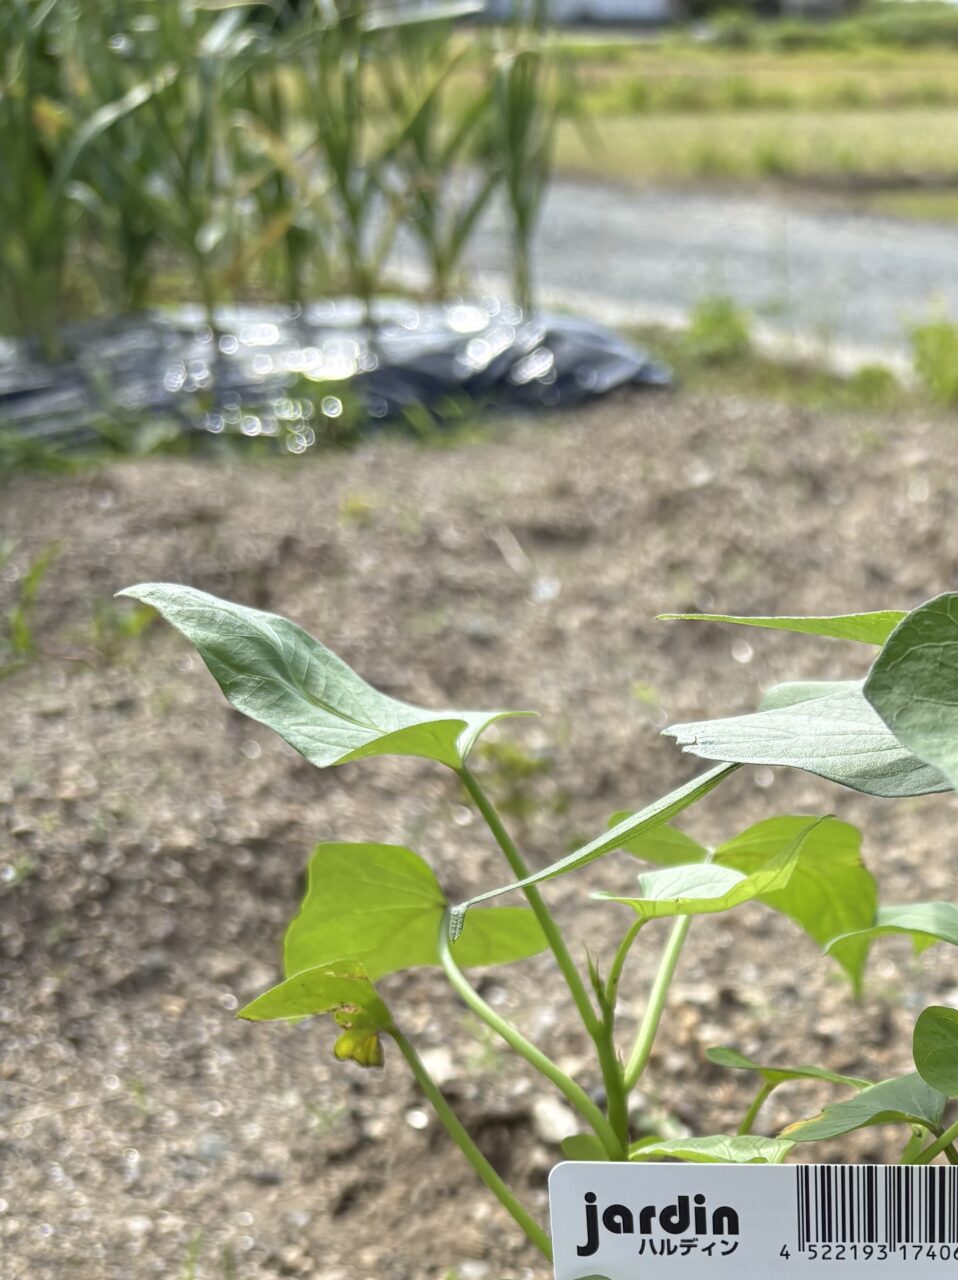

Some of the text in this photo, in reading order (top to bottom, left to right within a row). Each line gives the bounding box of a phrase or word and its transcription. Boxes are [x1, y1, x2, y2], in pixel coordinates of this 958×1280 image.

[576, 1191, 740, 1257] jardin
[637, 1238, 739, 1257] ハルディン
[779, 1246, 791, 1260] 4
[808, 1246, 889, 1261] 522193
